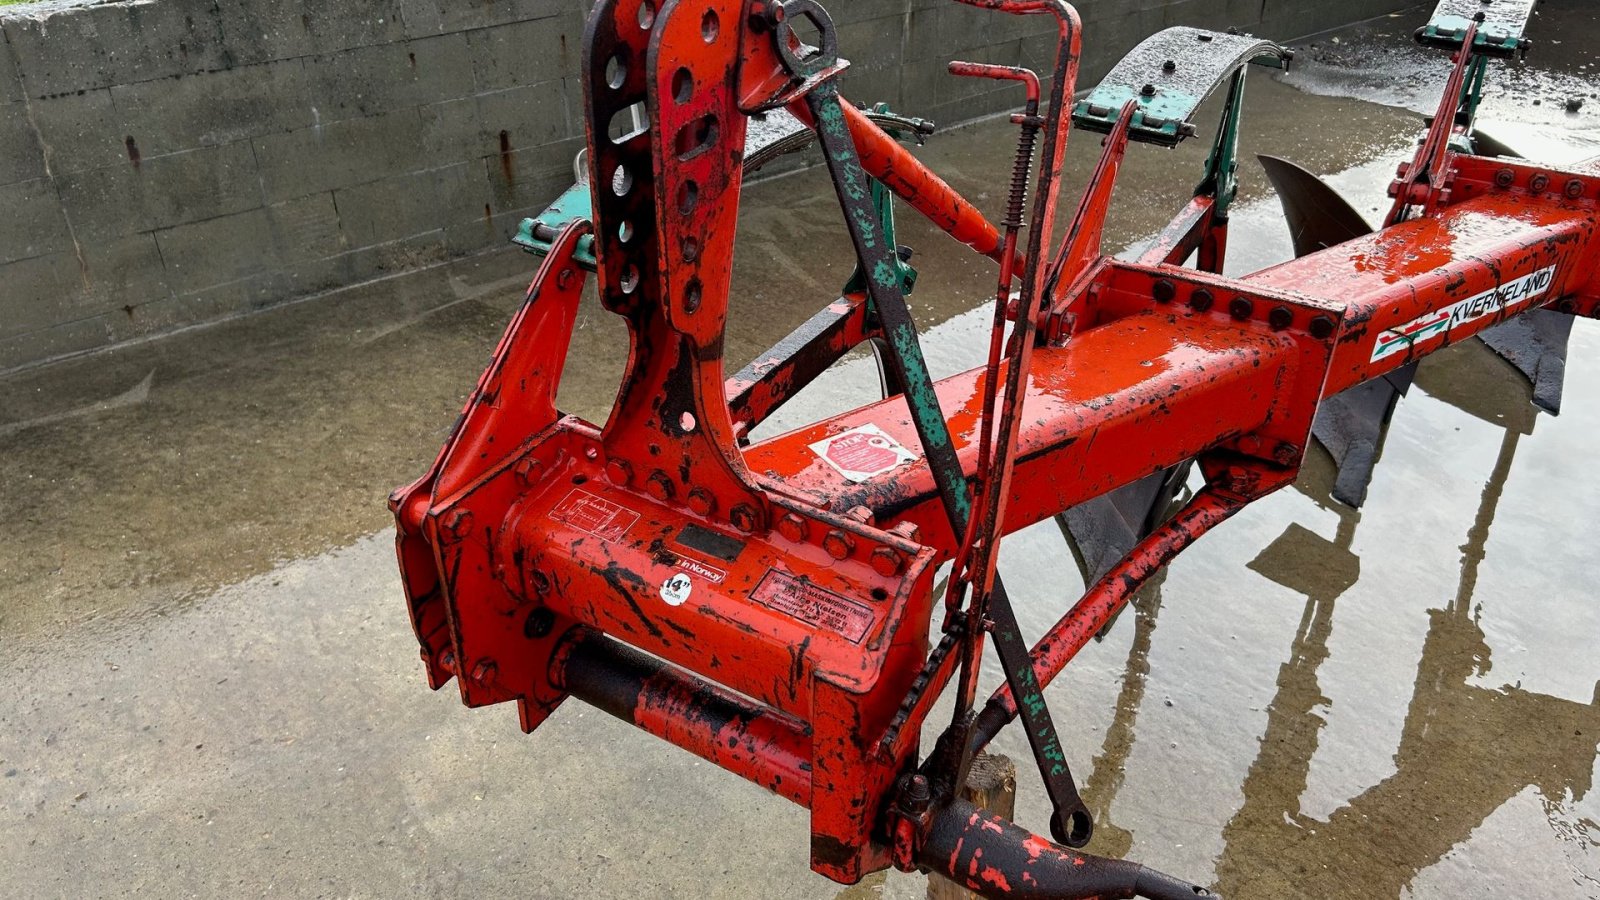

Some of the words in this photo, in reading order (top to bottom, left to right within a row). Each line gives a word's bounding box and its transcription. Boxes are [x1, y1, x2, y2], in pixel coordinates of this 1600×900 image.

[1449, 270, 1551, 322] KVERNELAND
[681, 560, 690, 568] in
[689, 563, 721, 582] Norway
[812, 600, 848, 620] Nielsen
